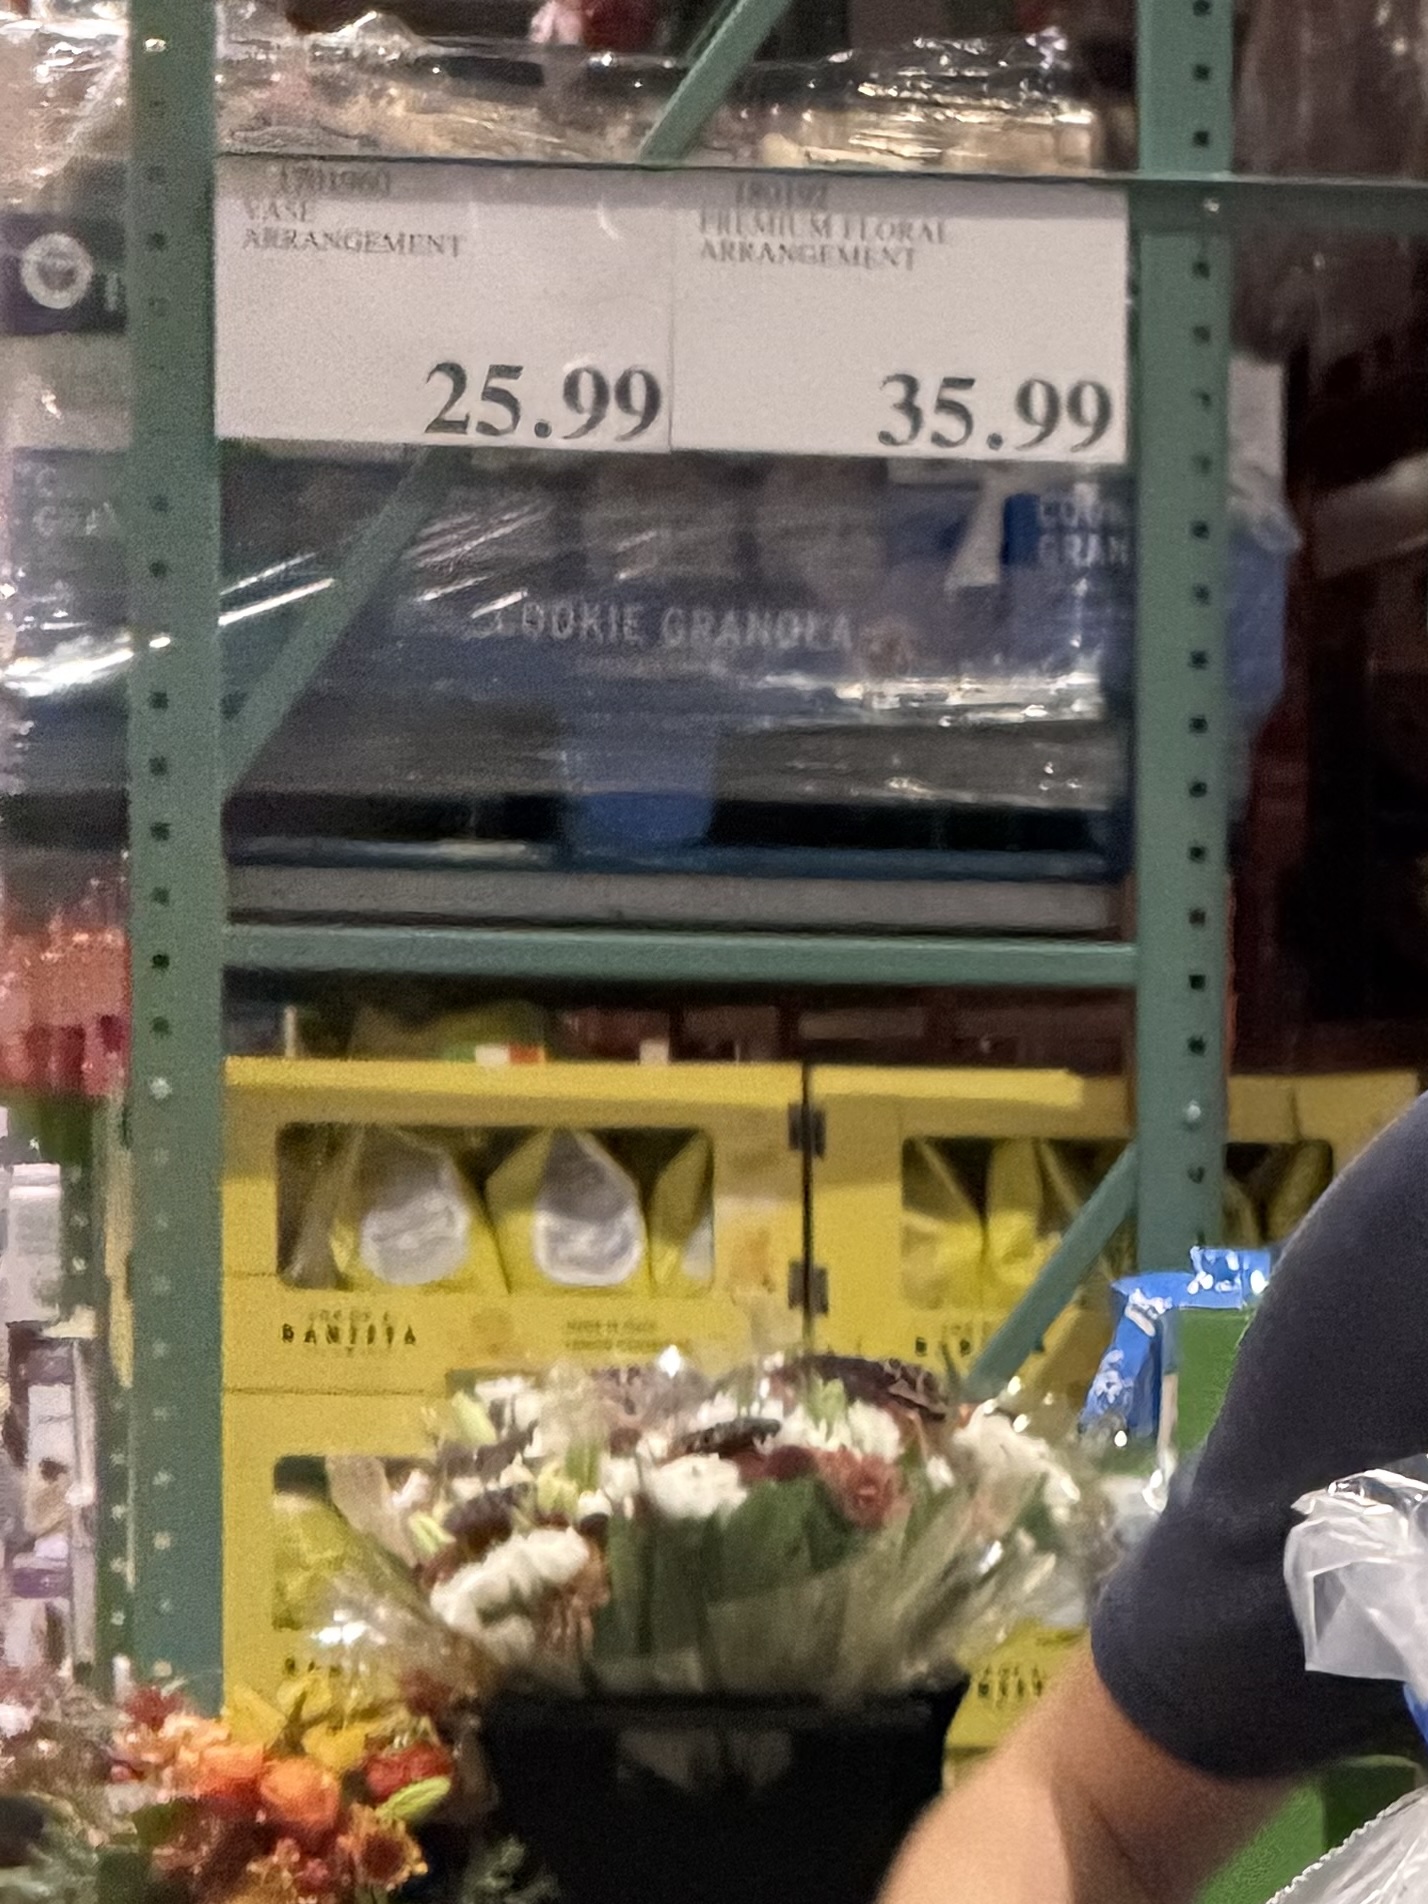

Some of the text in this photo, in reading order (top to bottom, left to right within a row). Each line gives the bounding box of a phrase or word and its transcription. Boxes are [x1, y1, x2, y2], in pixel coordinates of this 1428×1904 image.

[241, 227, 463, 258] ARRANGEMENT
[700, 239, 917, 270] ARRANGEMENT
[423, 361, 662, 442] 25.99
[876, 372, 1112, 453] 35.99
